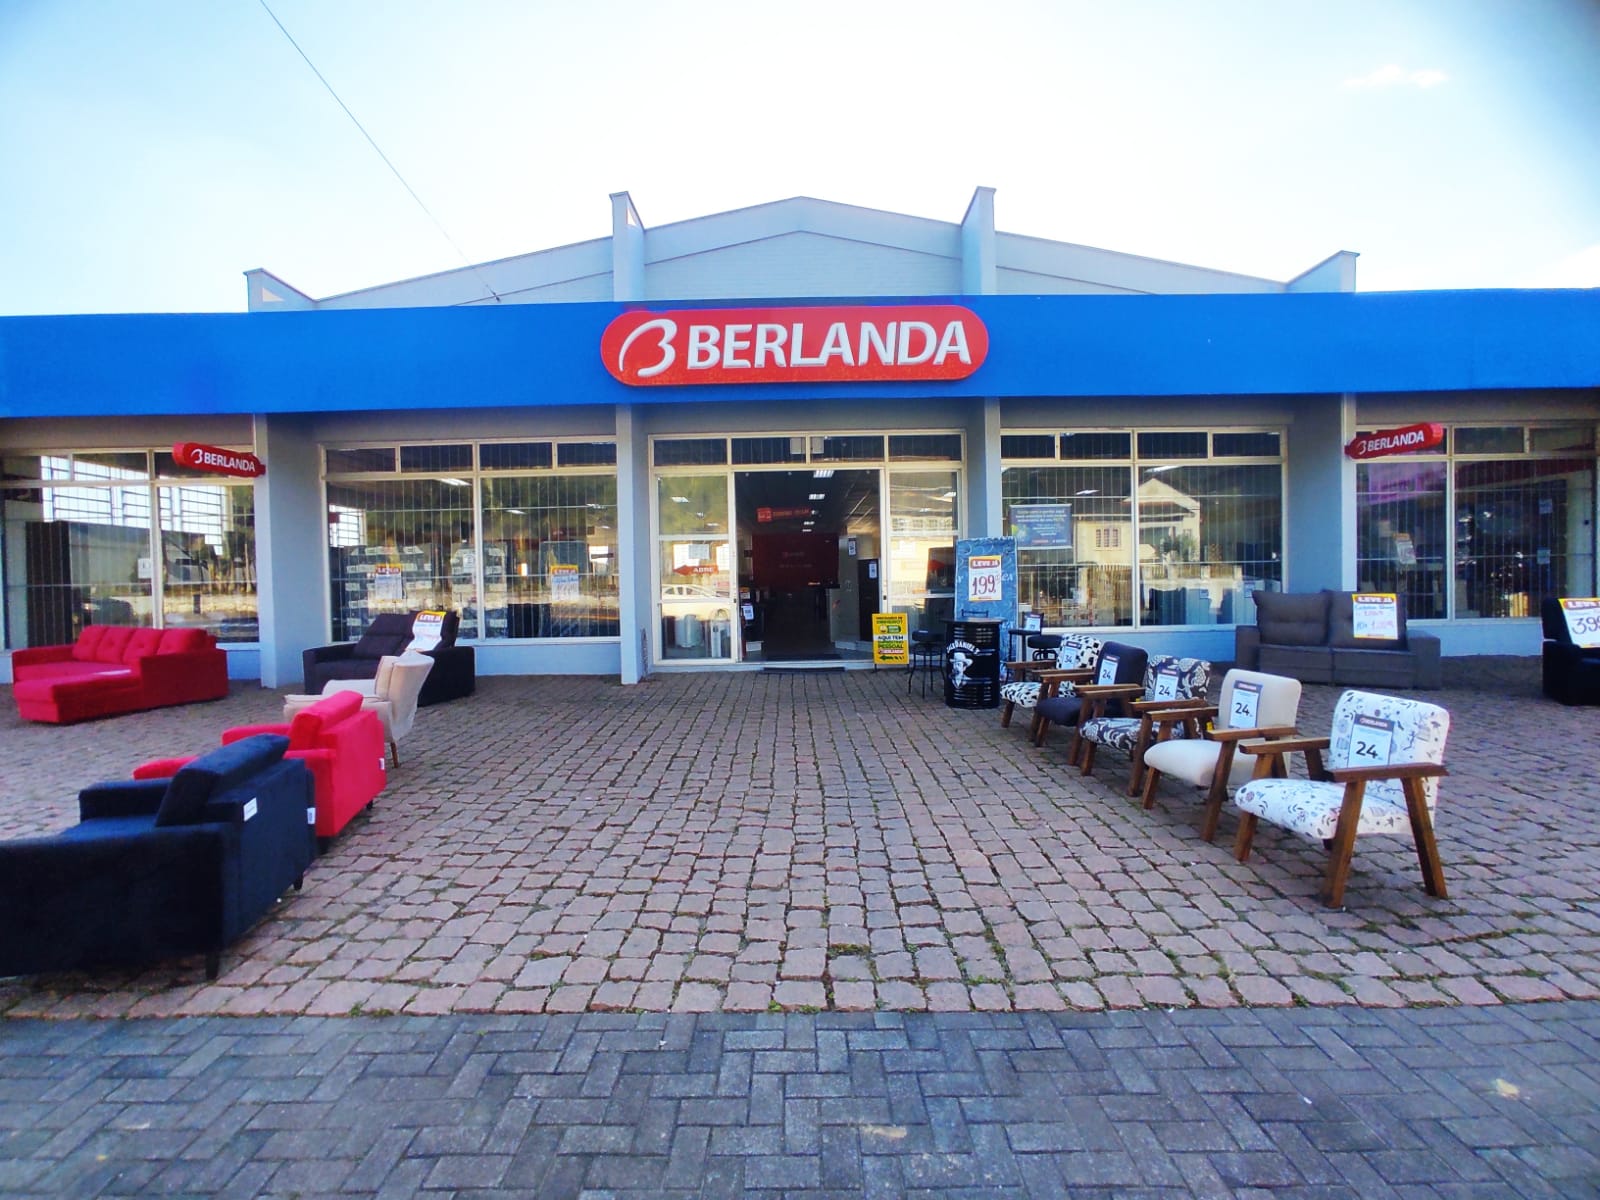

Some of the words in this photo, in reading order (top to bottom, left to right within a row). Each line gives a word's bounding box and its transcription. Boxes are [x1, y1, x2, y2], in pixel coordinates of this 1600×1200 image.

[686, 320, 972, 370] BERLANDA
[1367, 430, 1425, 452] BERLANDA
[203, 452, 256, 472] BERLANDA
[1356, 740, 1378, 760] 24
